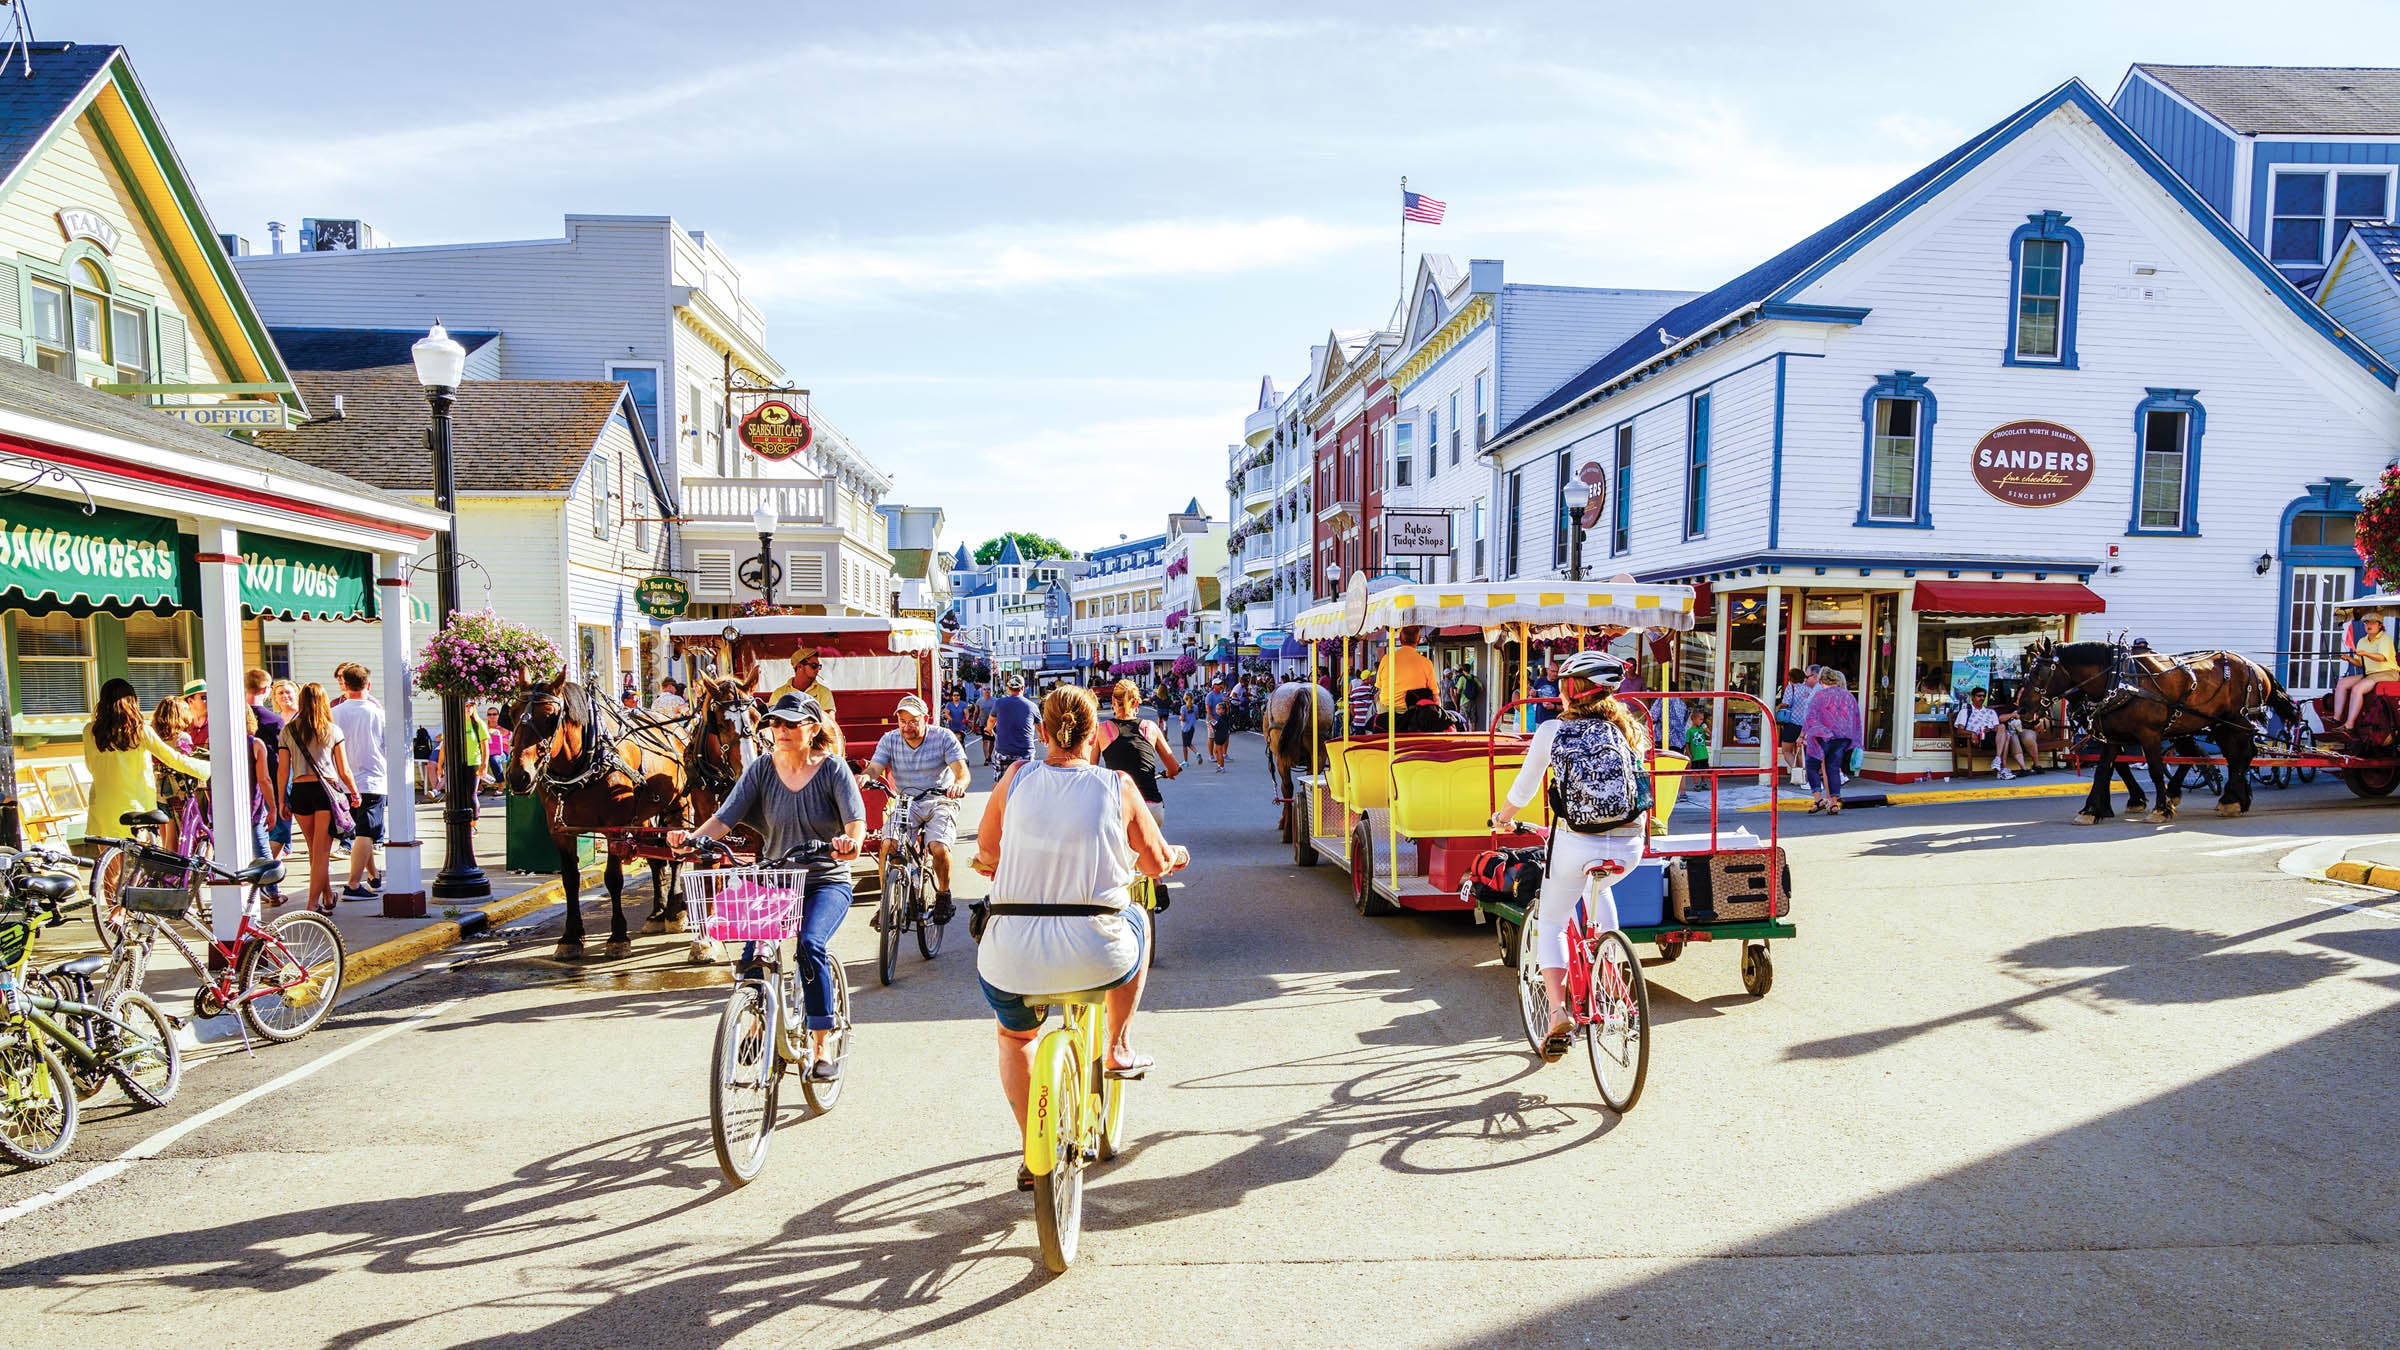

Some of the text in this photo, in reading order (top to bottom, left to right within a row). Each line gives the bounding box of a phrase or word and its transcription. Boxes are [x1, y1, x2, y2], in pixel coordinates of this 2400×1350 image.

[66, 213, 113, 245] TAXI
[194, 410, 277, 424] OFFICE
[748, 423, 803, 437] SEABISCUIT CAFÉ
[1992, 428, 2077, 442] CHOCOLATE WORTH SHARING
[1979, 448, 2089, 472] SANDERS
[2008, 490, 2035, 500] SINCE
[1404, 521, 1432, 537] Ryba's
[1392, 534, 1444, 549] Fudge Shops
[243, 552, 340, 599] HOT DOGS
[641, 581, 649, 592] To
